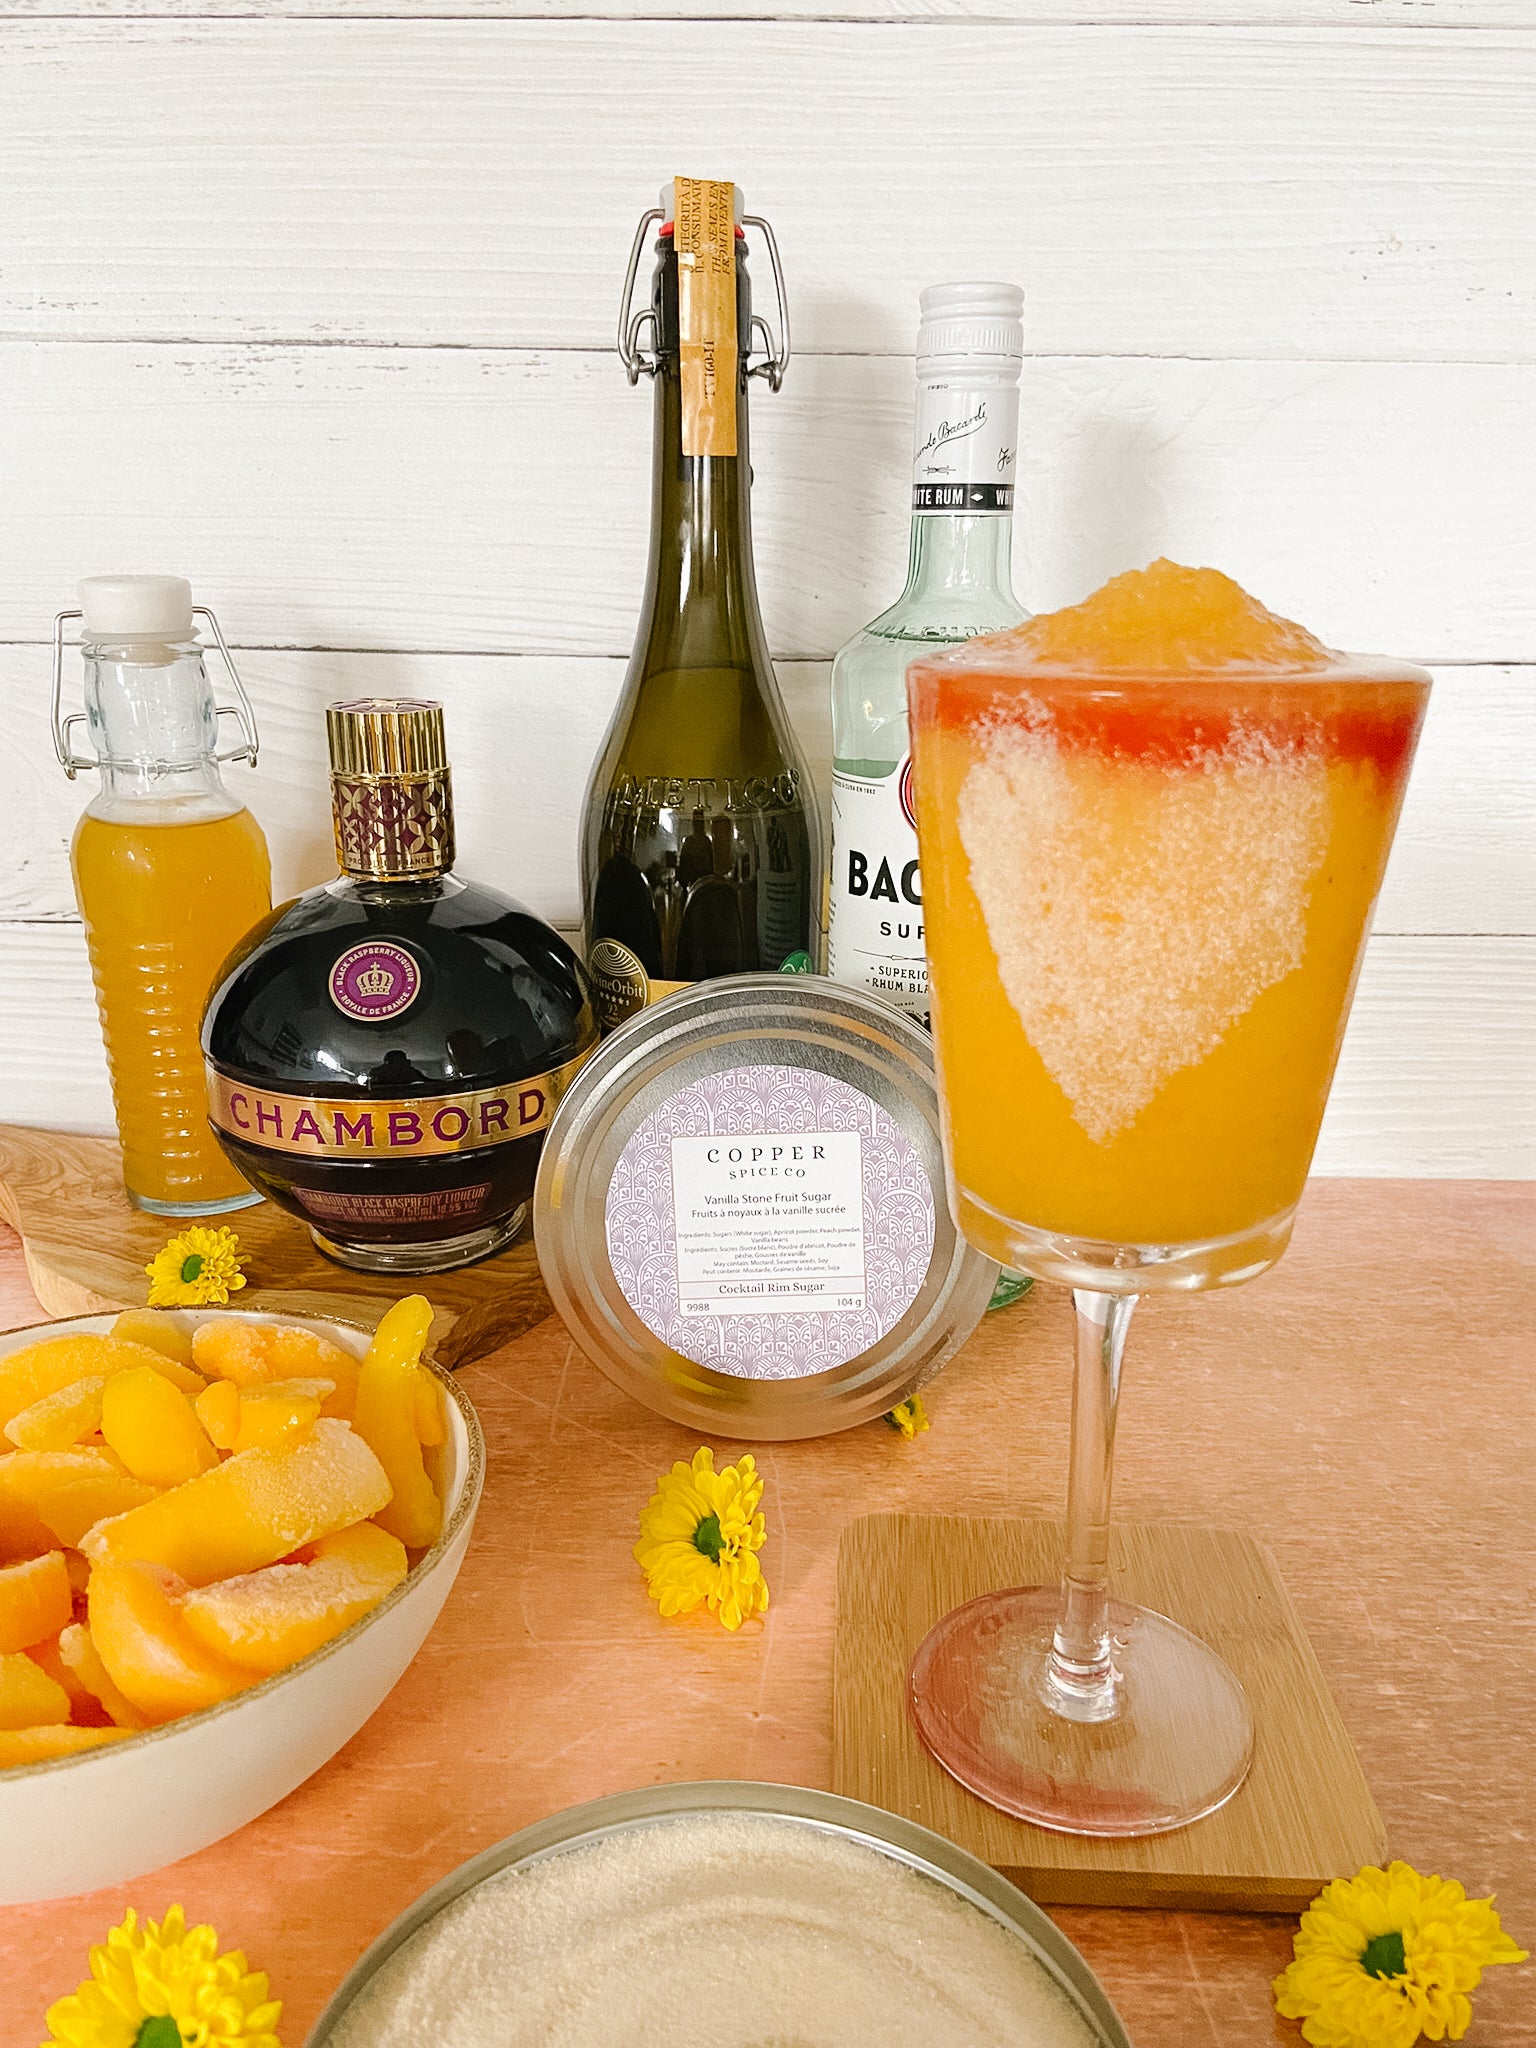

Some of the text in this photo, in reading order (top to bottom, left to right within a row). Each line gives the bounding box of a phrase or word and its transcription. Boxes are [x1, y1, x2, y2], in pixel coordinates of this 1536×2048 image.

[709, 245, 721, 273] THS
[936, 488, 963, 505] RUM
[848, 850, 922, 906] BAC
[336, 947, 414, 986] BLACK RASPBERRY LIQUEUR
[872, 978, 904, 992] RHUM
[341, 995, 367, 1014] ROYALE
[382, 992, 411, 1013] FRANCE
[230, 1089, 546, 1147] CHAMBORD
[707, 1146, 825, 1163] COPPER
[729, 1167, 806, 1180] SPICE CO
[351, 1196, 383, 1209] BLACK
[385, 1193, 442, 1208] RASPBERRY
[444, 1187, 486, 1204] LIQUEUR
[704, 1192, 832, 1205] Vanilla Stone Fruit Sugar
[692, 1205, 846, 1219] Fruits à noyaux à la vanille sucrée
[719, 1282, 825, 1294] Cocktail Rim Sugar
[686, 1303, 710, 1312] 9988
[837, 1298, 861, 1308] 104 g
